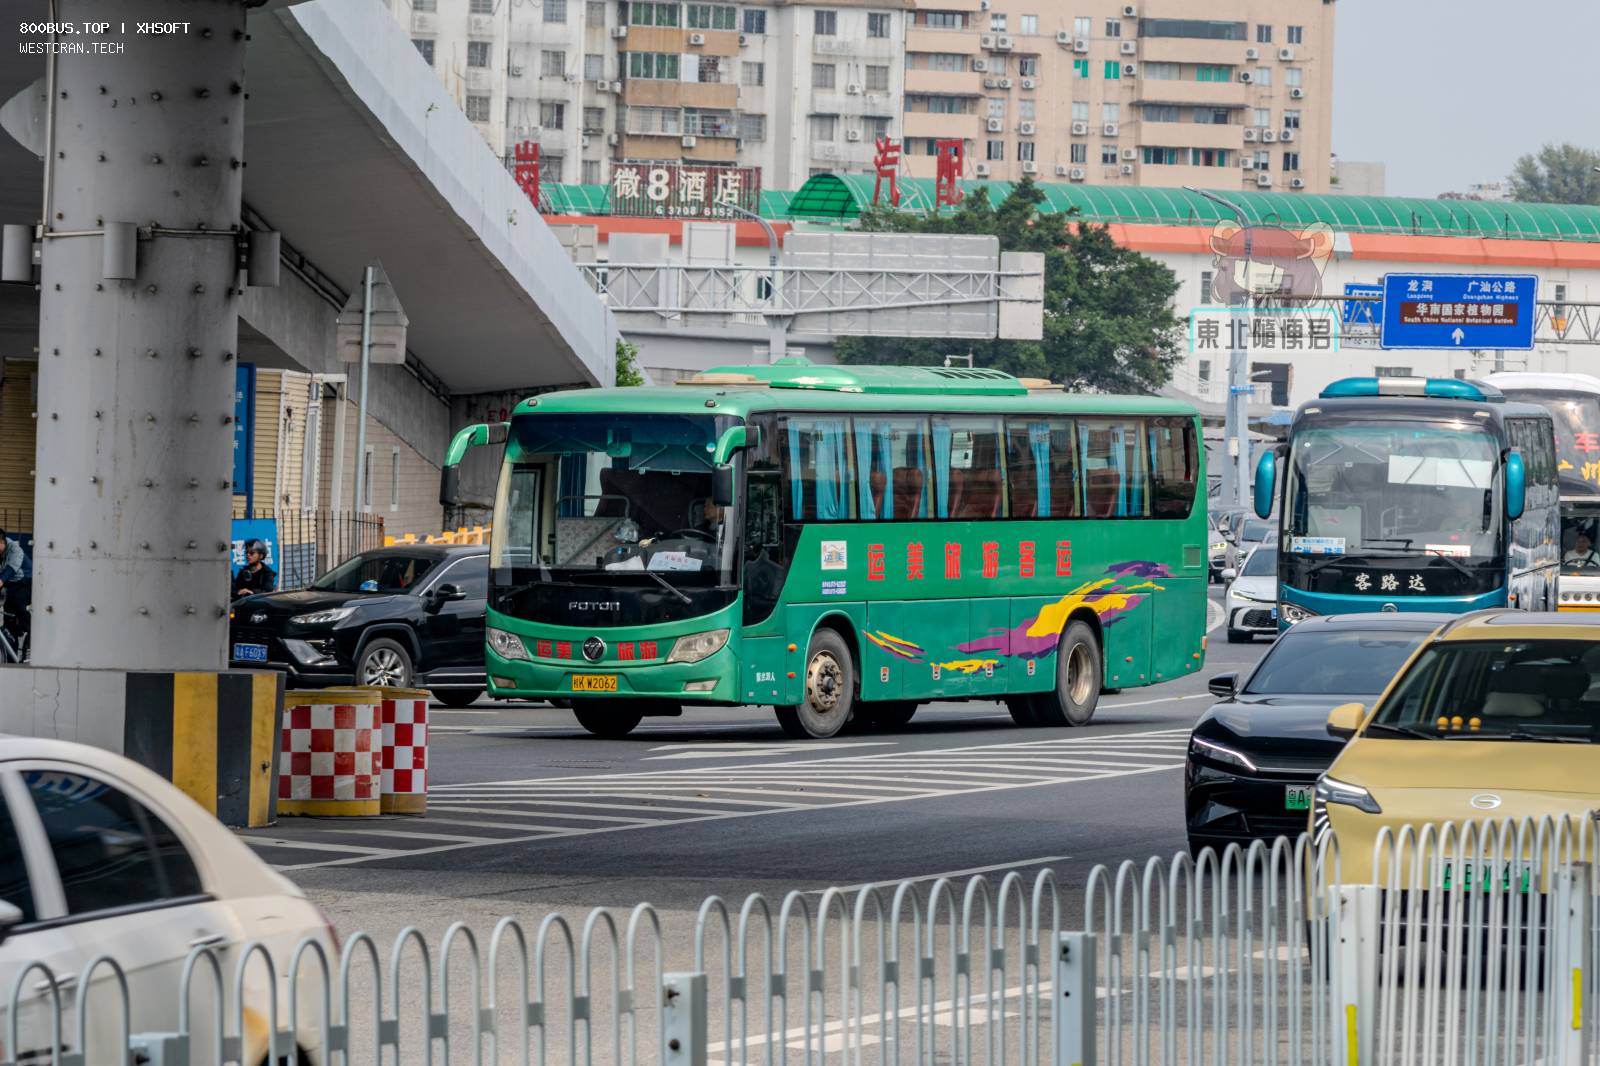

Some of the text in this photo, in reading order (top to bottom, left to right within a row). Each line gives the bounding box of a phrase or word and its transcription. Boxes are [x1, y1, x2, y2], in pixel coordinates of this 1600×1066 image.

[613, 167, 742, 204] 微8酒店
[1407, 280, 1516, 293] 龙洞 广汕公路
[1416, 303, 1504, 317] 华南国家植物园
[867, 540, 1072, 581] 运美旅游客运
[1355, 572, 1426, 591] 客路达
[568, 601, 620, 611] FOTON
[537, 640, 658, 661] 运美 旅游
